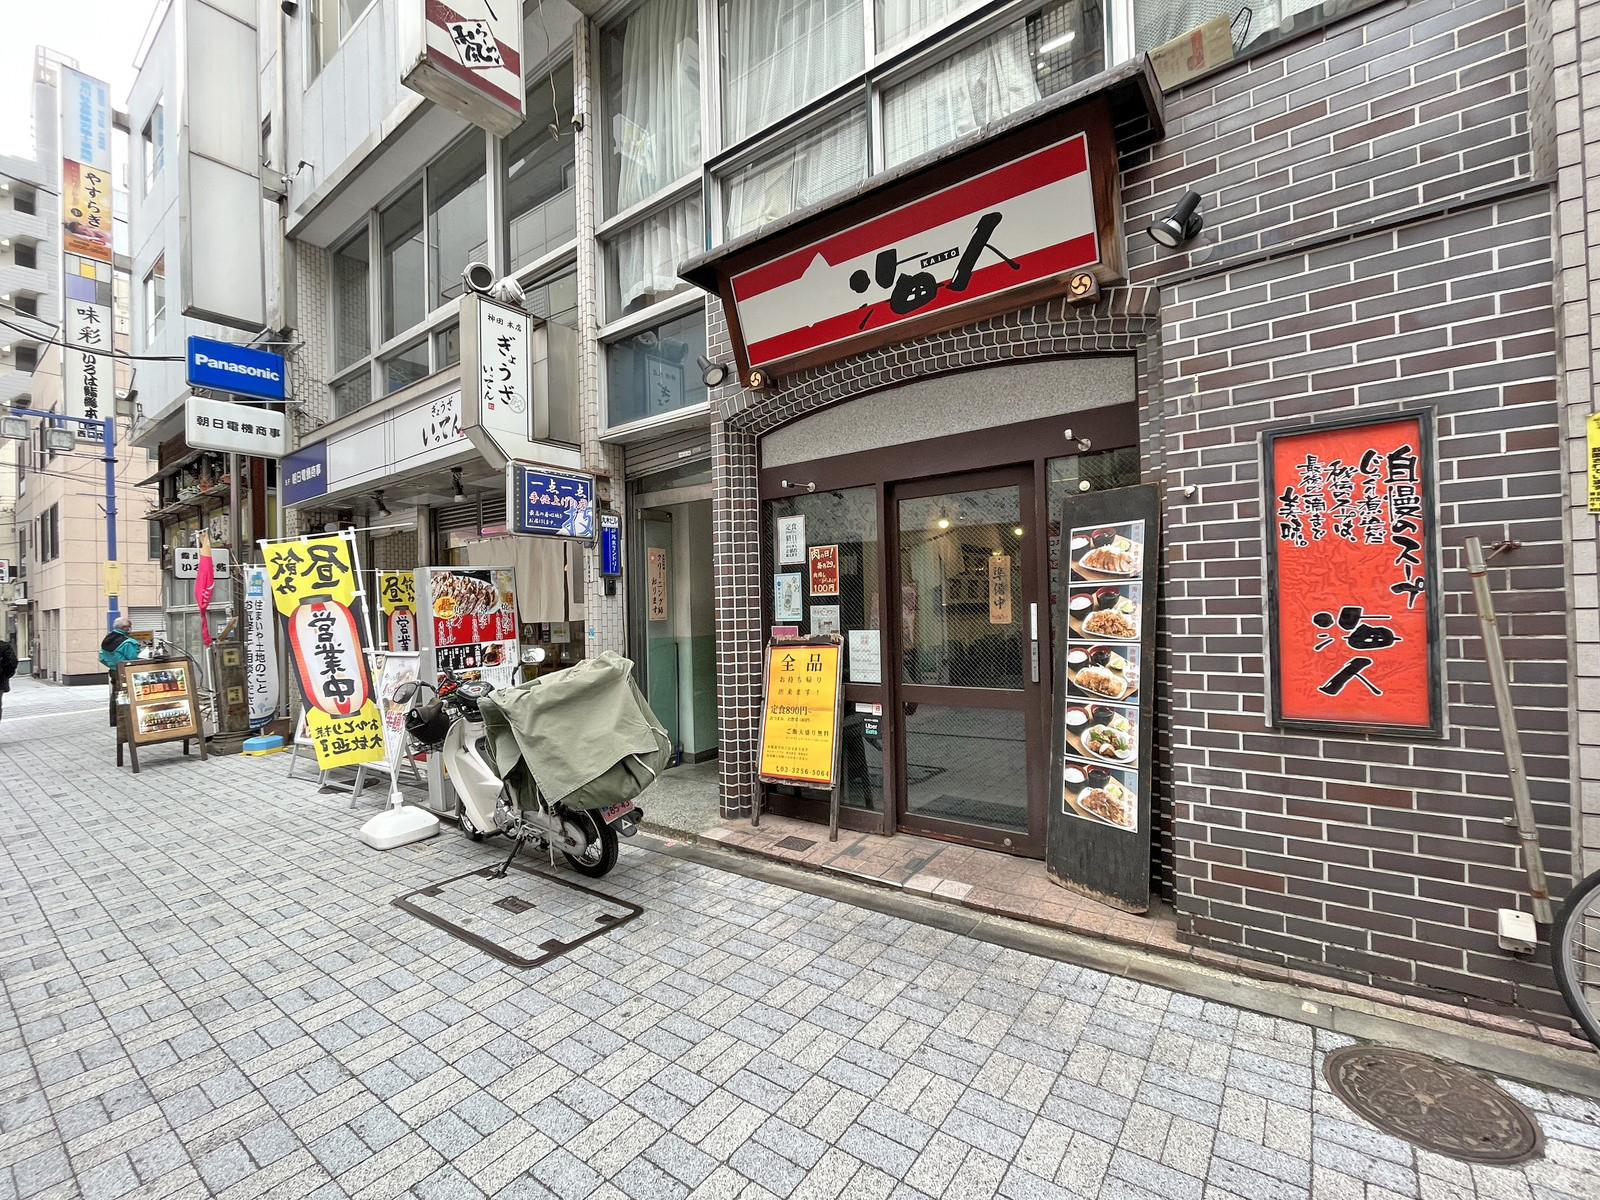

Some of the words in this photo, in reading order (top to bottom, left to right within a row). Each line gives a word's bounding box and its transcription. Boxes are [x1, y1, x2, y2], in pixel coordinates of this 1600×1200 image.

[84, 172, 102, 228] やすらぎ
[922, 249, 959, 268] KAITO
[76, 305, 102, 345] 味彩
[487, 312, 504, 326] 神田
[506, 320, 523, 333] 本店
[194, 353, 280, 382] Panasonic
[496, 334, 517, 406] ぎょうざ
[483, 364, 495, 401] いってん
[430, 396, 453, 418] ぎょうざ
[196, 415, 281, 439] 朝日電機商事
[422, 413, 463, 447] いってん
[291, 463, 322, 485] 朝日電機商事
[530, 478, 587, 499] 一点一点
[1296, 453, 1327, 541] 最後の一滴まで
[1277, 486, 1309, 547] 美味。
[1384, 444, 1426, 610] 自慢のスープ
[383, 576, 404, 603] 昼
[813, 583, 835, 592] 100円
[992, 566, 1008, 610] 準備中
[254, 600, 268, 694] 住まいや土地のこと
[1312, 605, 1403, 697] 海人
[781, 653, 823, 672] 全品
[779, 676, 822, 684] お持ち帰り
[865, 723, 878, 731] Uber
[780, 766, 830, 777] 03-3256-5064
